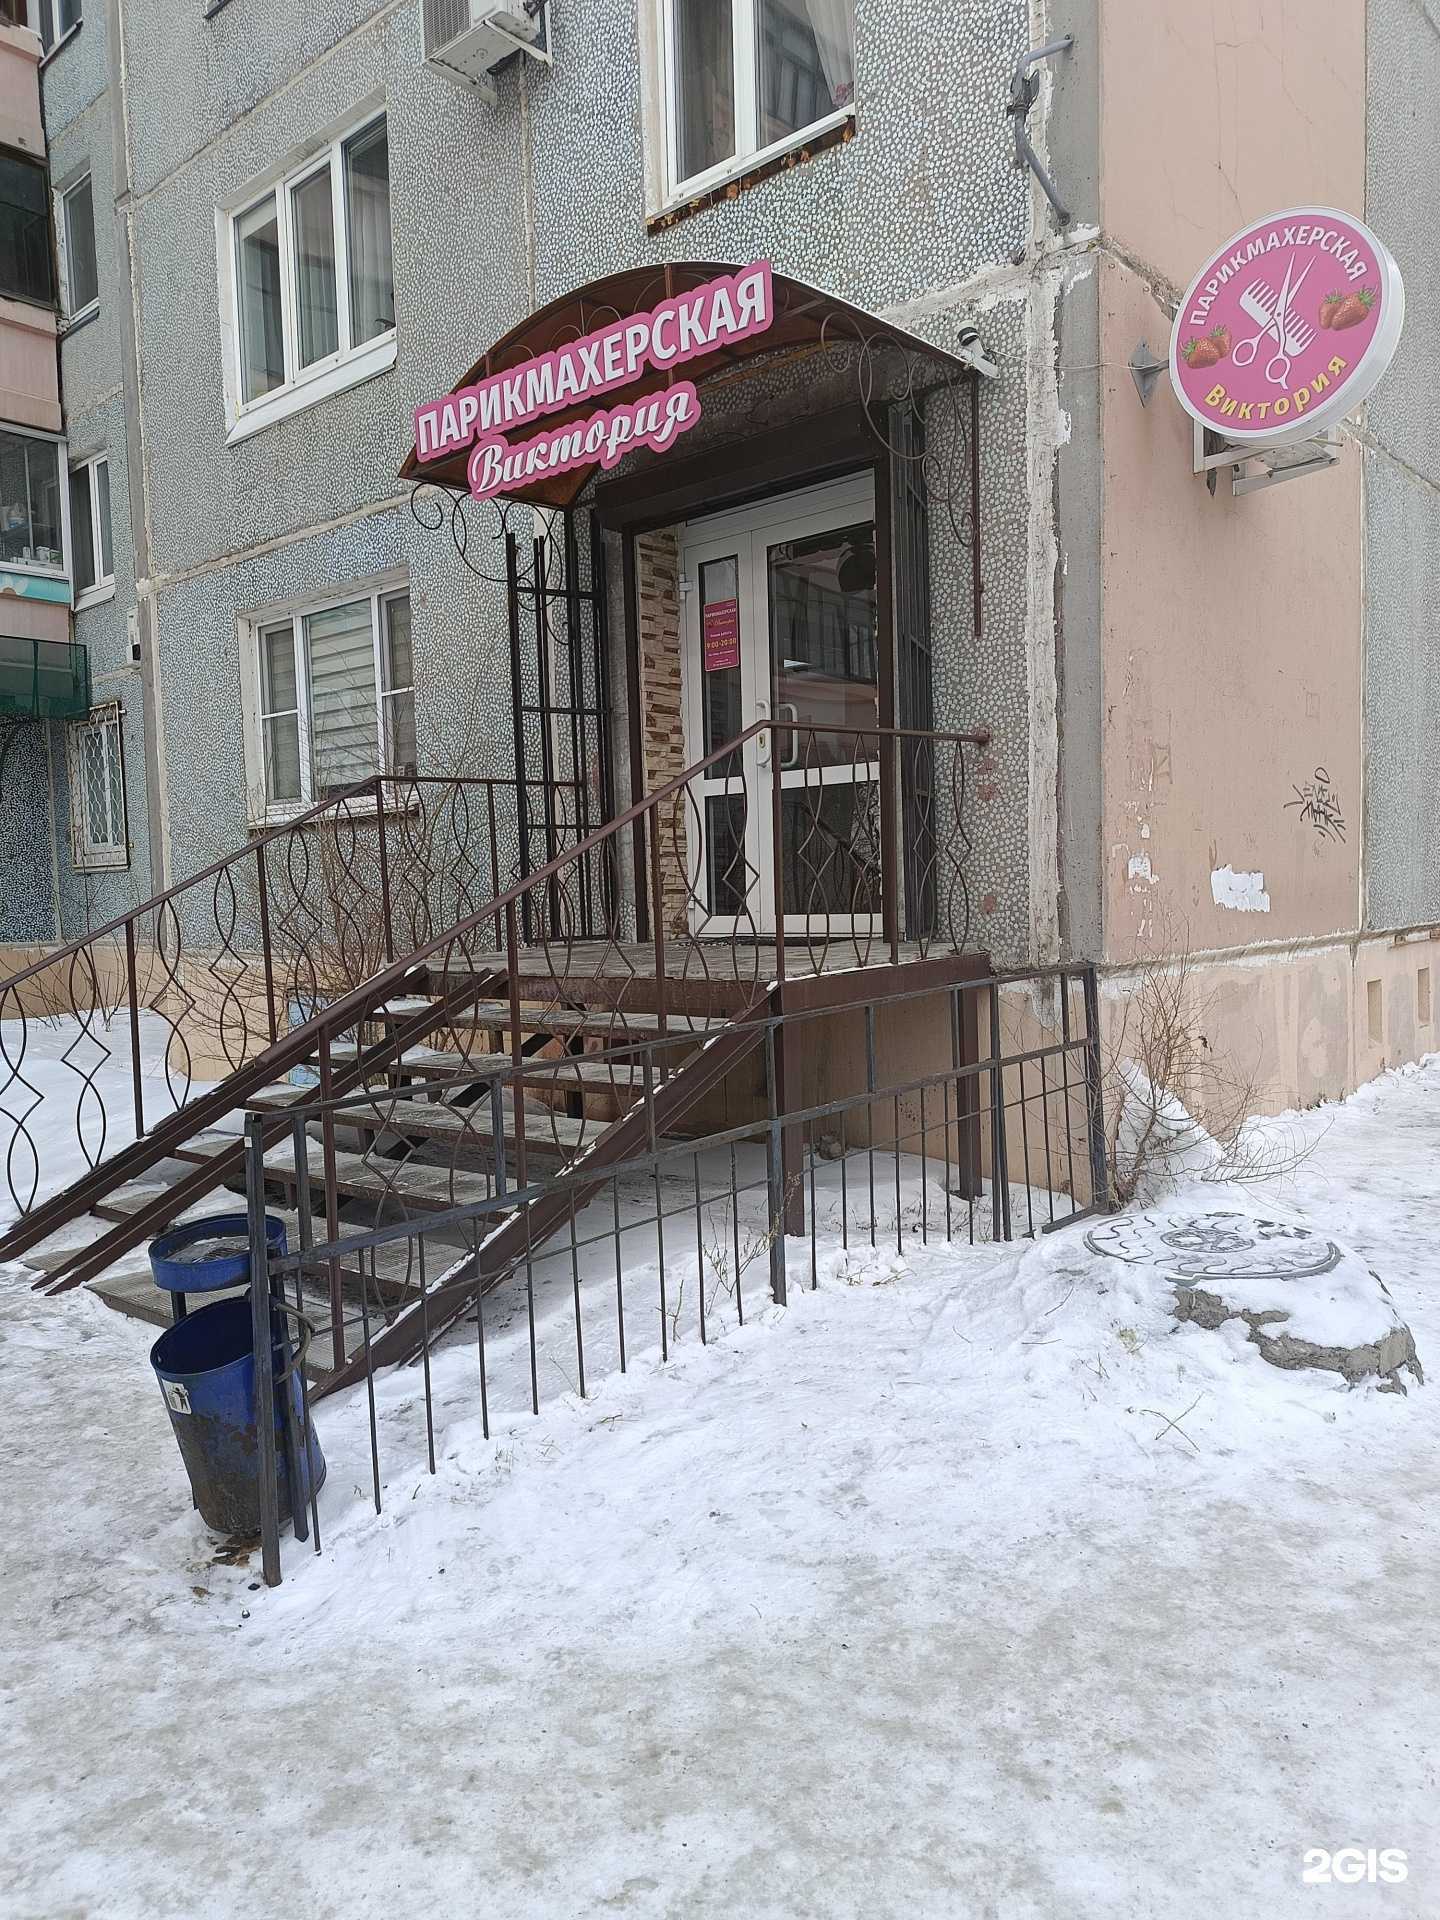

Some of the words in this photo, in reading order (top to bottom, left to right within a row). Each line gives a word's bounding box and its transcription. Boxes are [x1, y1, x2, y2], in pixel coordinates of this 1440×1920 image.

[1190, 225, 1367, 326] ПАРИКМАХЕРСКАЯ
[417, 271, 767, 454] ПАРИКМАХЕРСКАЯ
[1204, 356, 1347, 420] Виктория
[472, 392, 695, 493] Виктория
